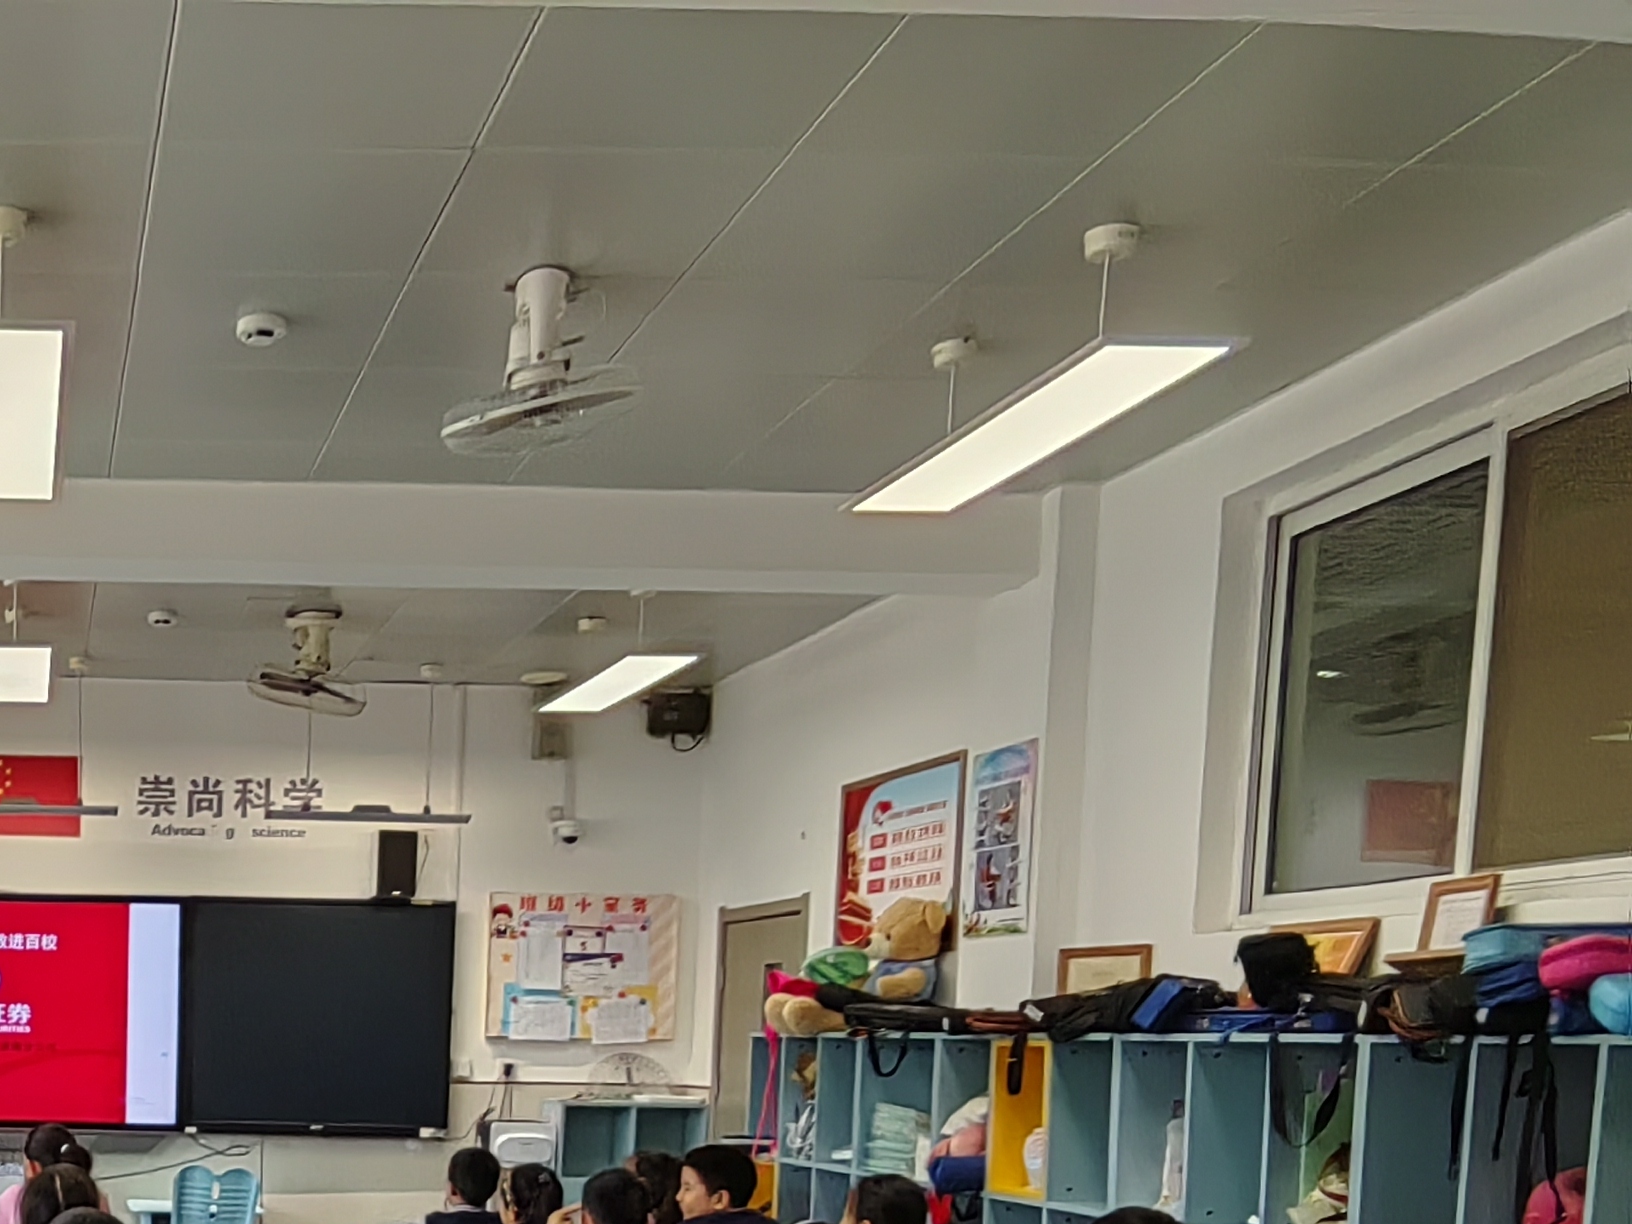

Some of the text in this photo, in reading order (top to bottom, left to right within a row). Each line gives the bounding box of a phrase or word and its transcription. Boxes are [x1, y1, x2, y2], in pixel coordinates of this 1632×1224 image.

[137, 775, 323, 819] 崇尚科学
[252, 826, 306, 838] science
